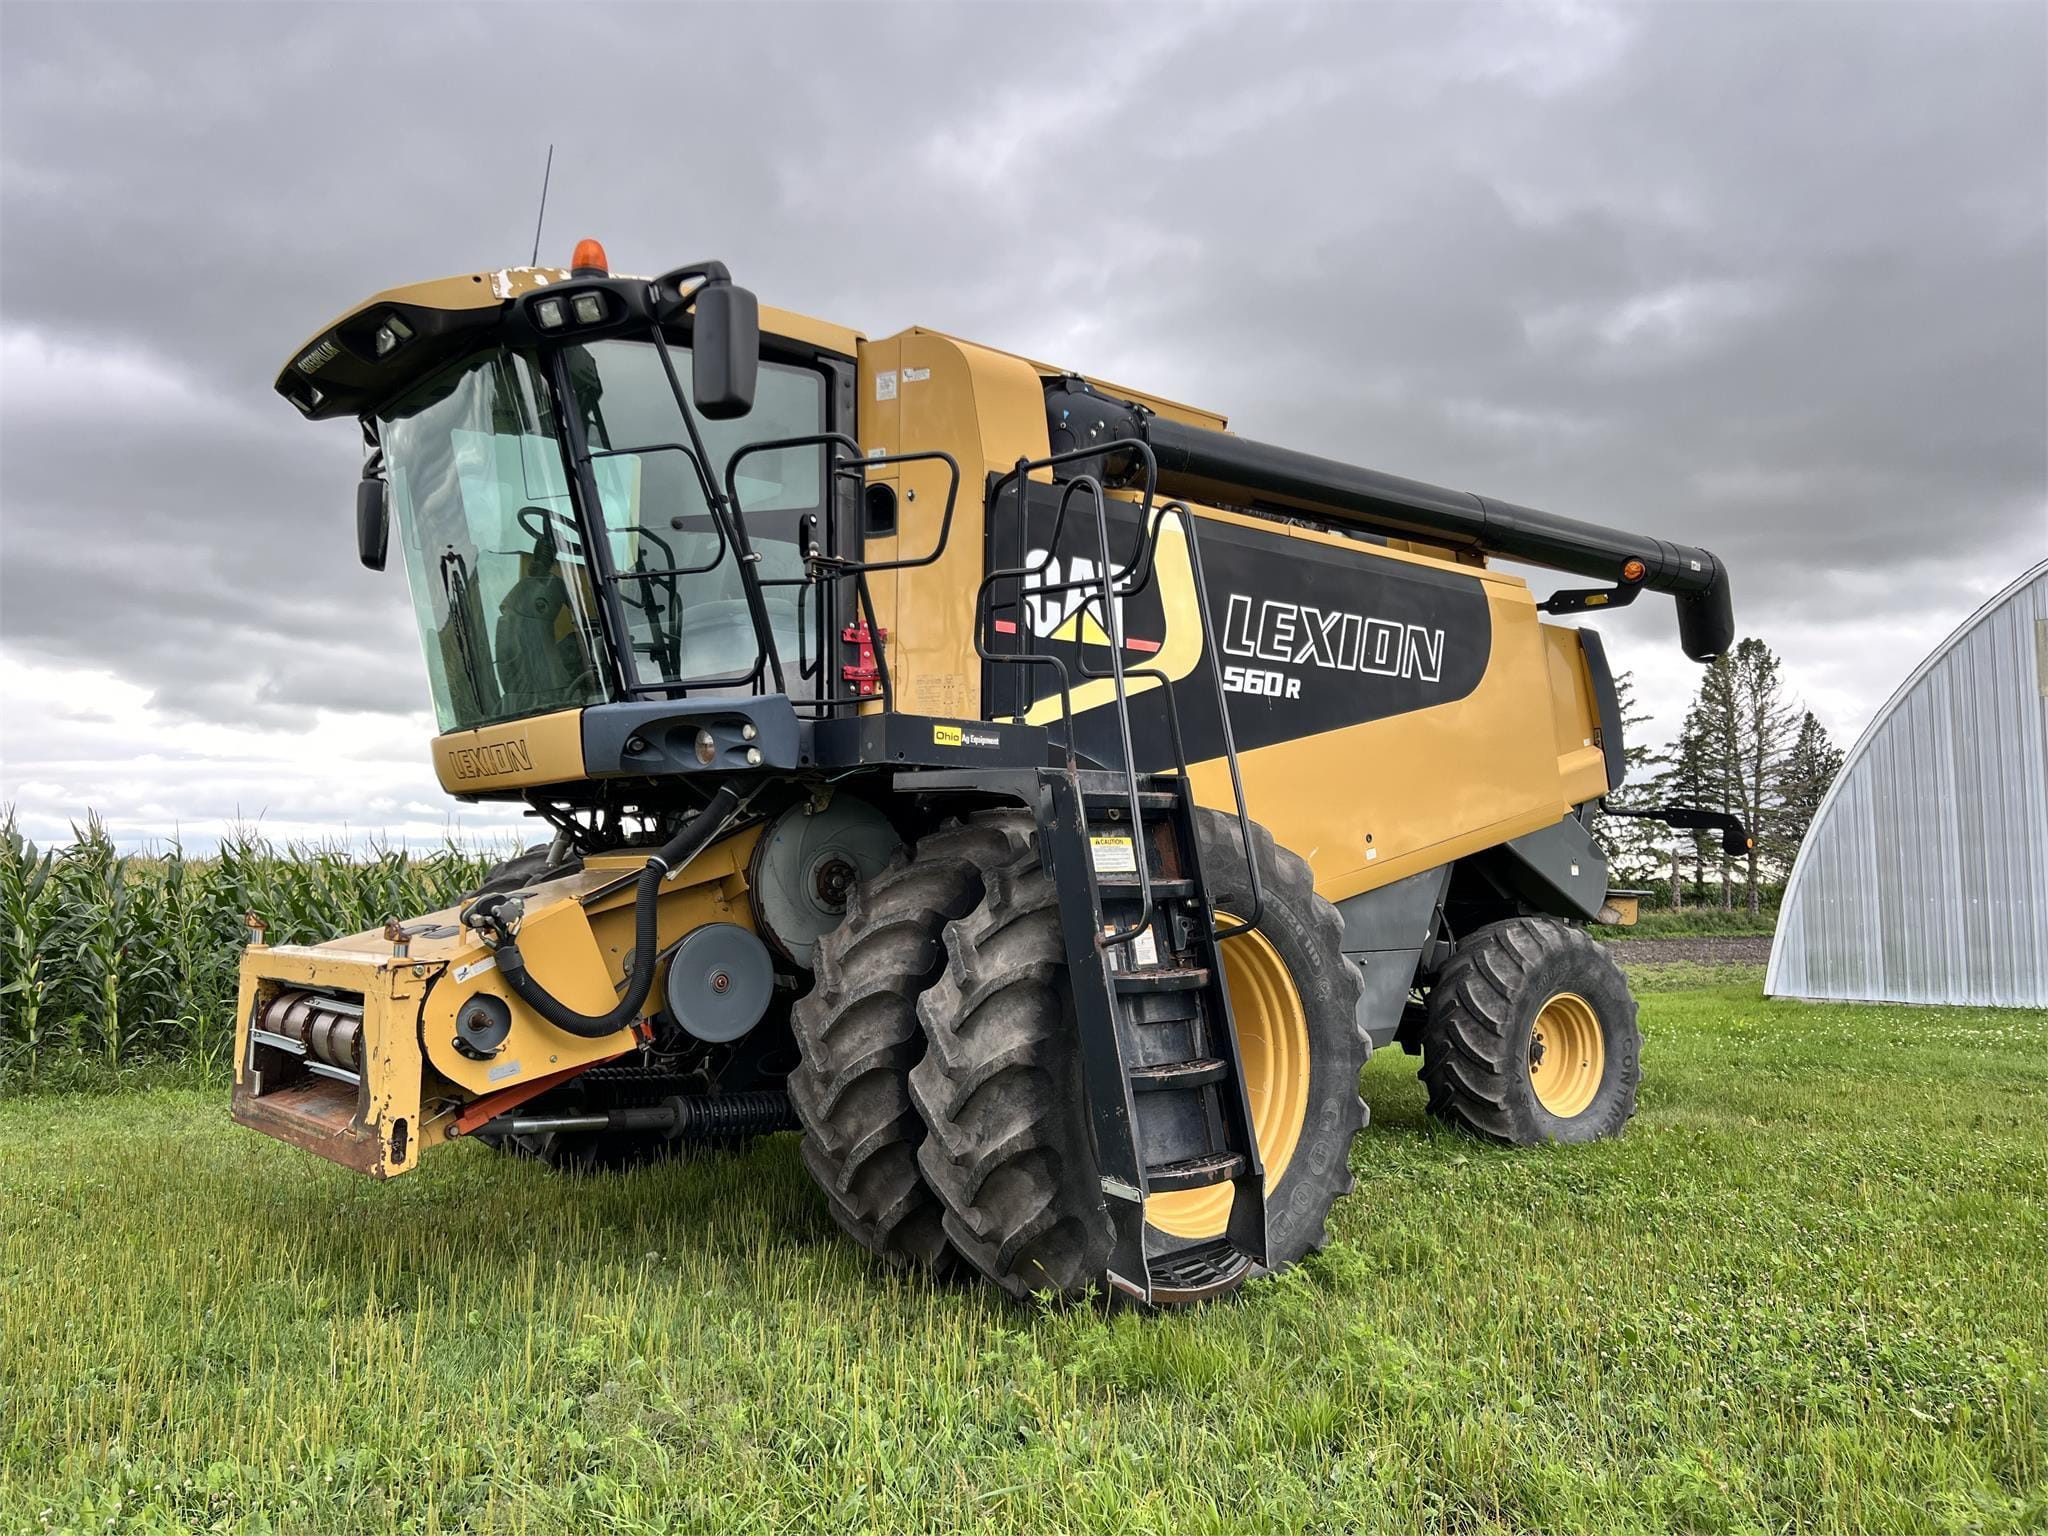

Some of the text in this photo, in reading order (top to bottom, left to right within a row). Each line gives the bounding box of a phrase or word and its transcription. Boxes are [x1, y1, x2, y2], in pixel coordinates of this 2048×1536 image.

[1024, 548, 1137, 649] CAT
[1222, 593, 1446, 684] LEXION
[1222, 665, 1301, 700] 560 R
[935, 731, 960, 742] Ohio
[961, 733, 970, 745] Ag
[448, 739, 533, 780] LEXION
